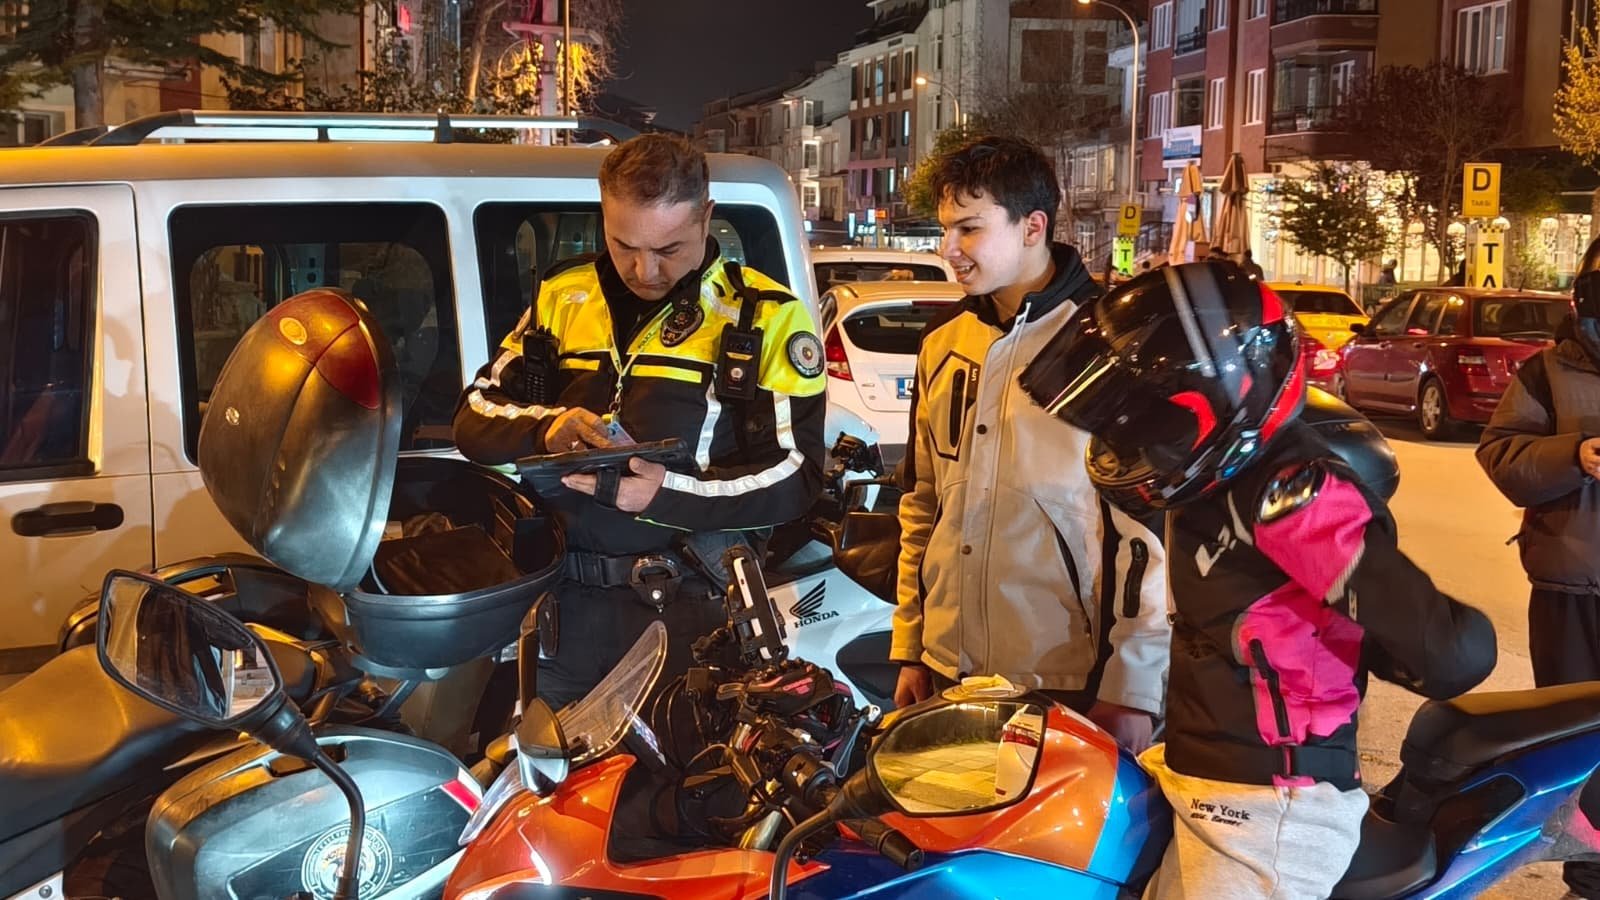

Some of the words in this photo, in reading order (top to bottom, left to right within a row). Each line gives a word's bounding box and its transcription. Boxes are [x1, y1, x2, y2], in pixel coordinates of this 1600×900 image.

[1472, 168, 1491, 191] D
[1124, 205, 1136, 219] D
[794, 610, 840, 628] HONDA
[1190, 798, 1216, 813] New
[1220, 804, 1251, 820] York
